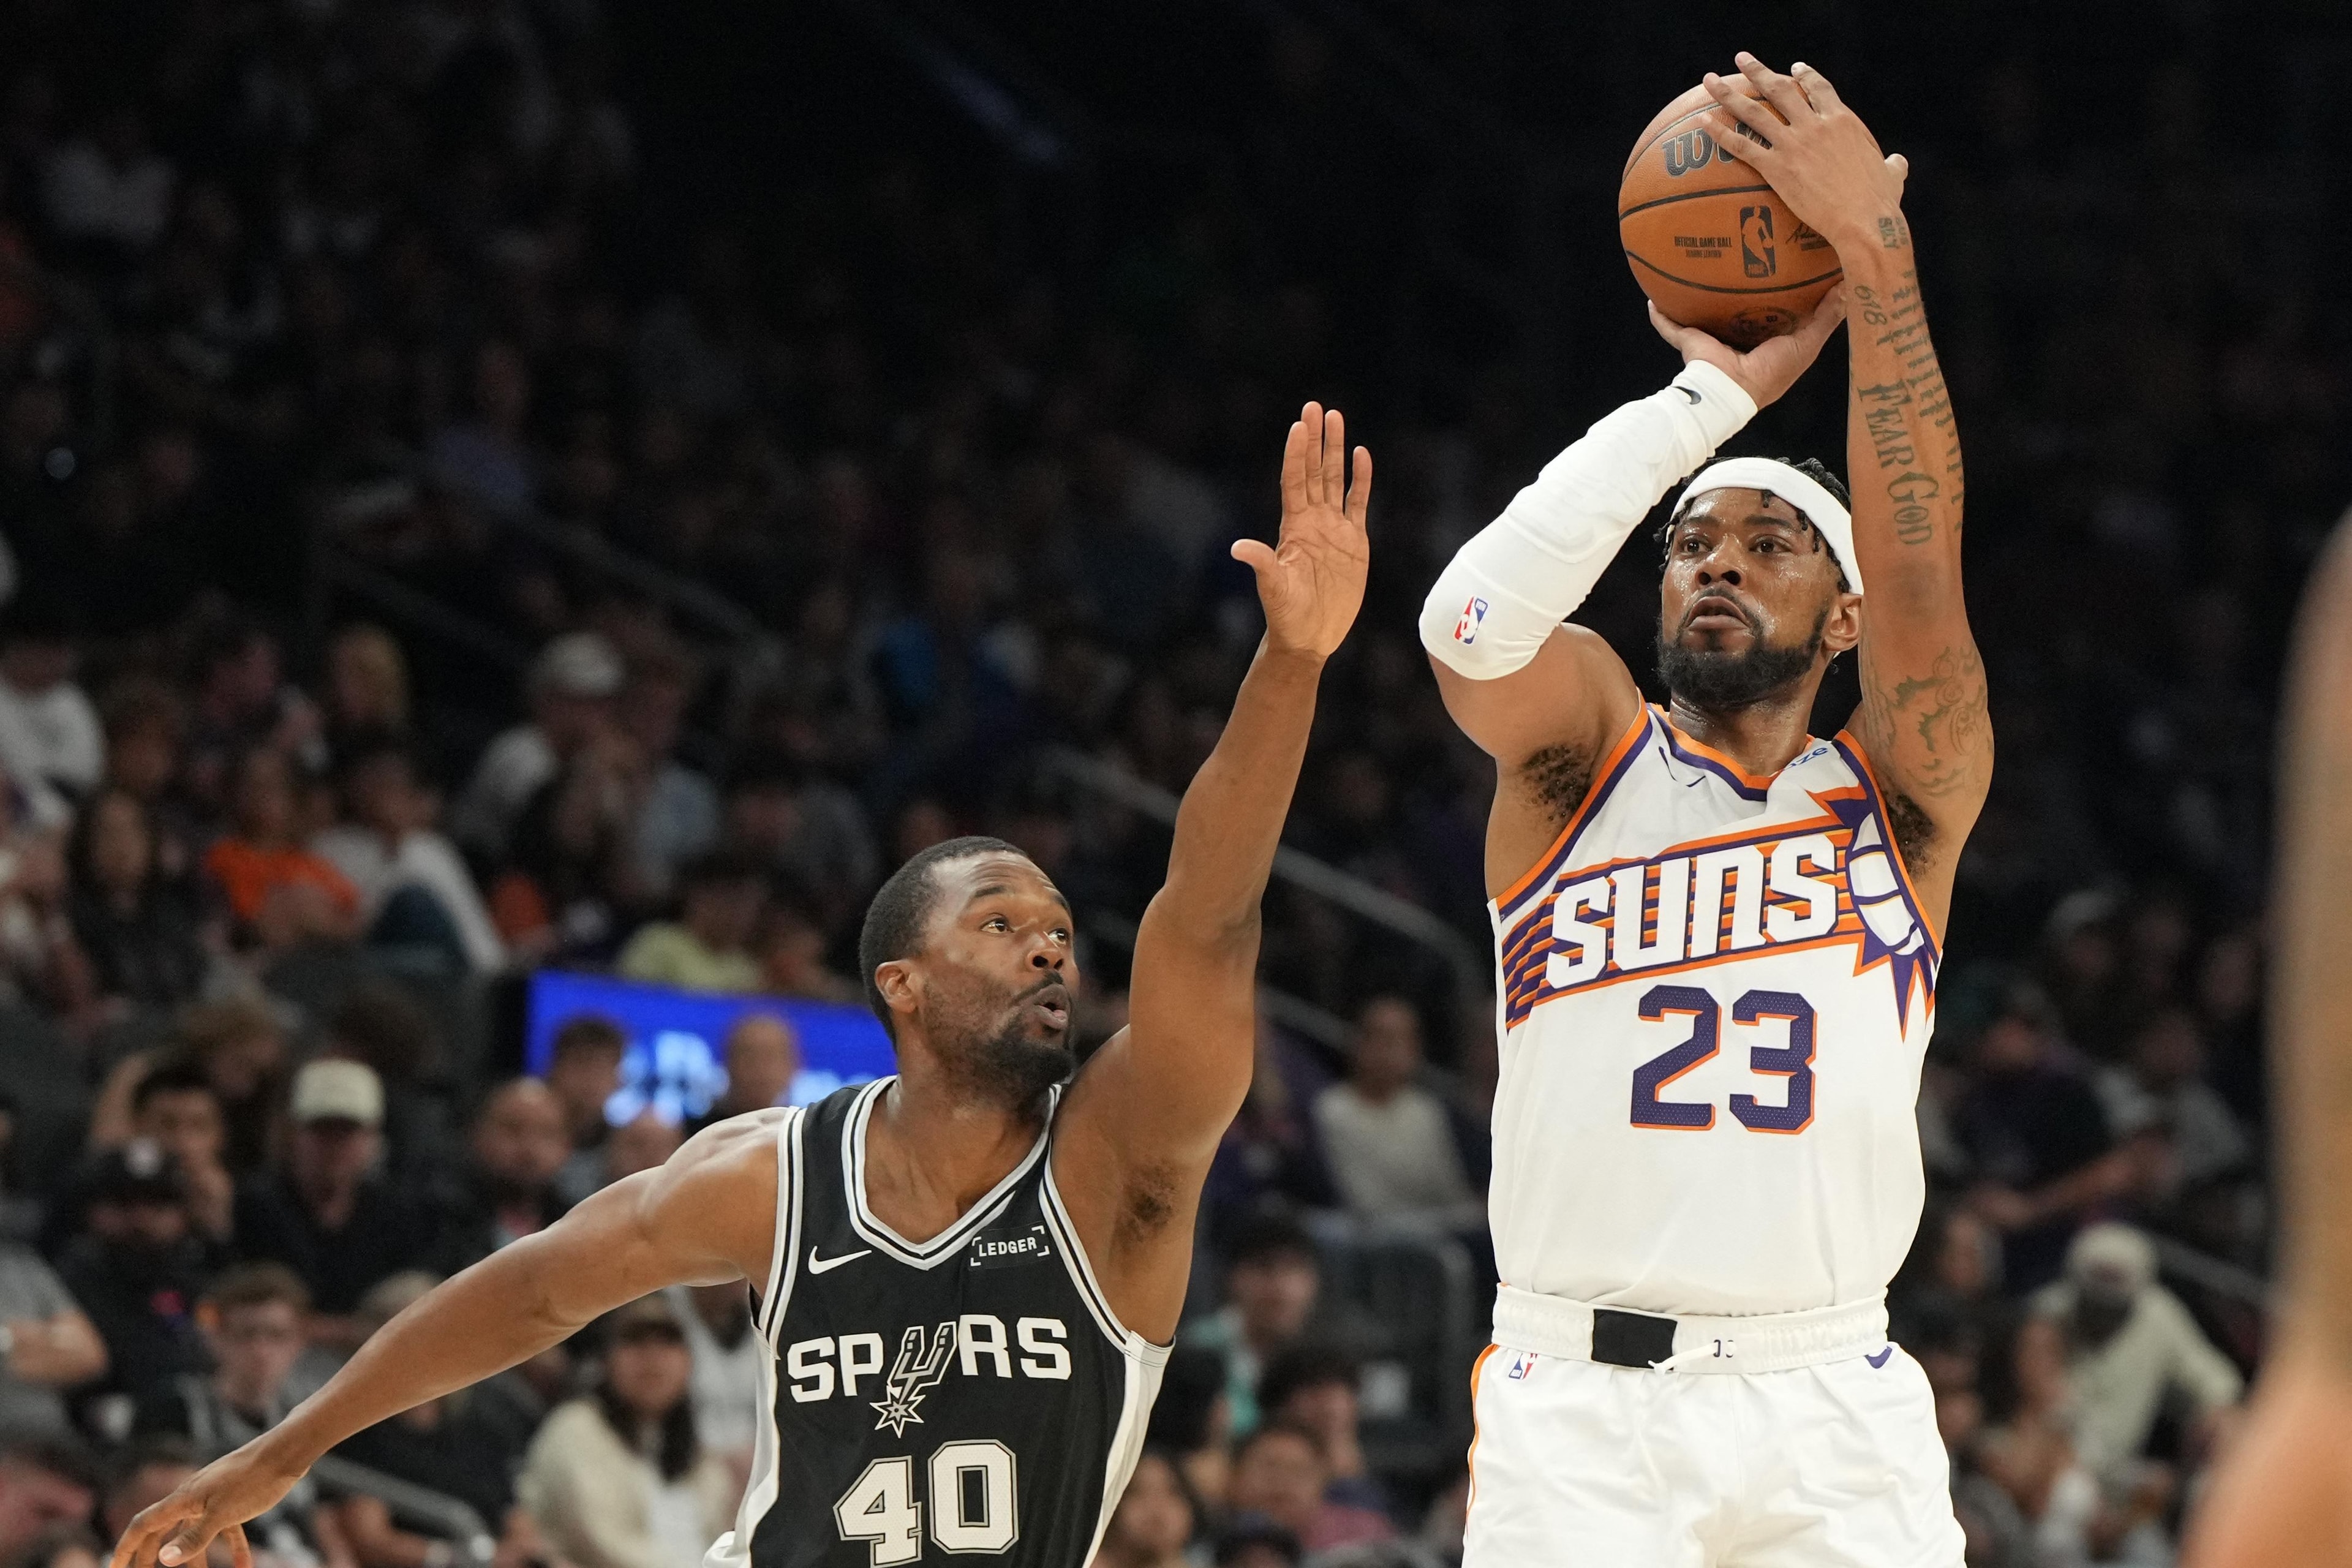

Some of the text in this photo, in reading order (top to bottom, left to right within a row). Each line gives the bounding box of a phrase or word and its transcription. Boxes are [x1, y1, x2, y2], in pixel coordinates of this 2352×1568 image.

[1854, 285, 1887, 326] 618
[1630, 984, 1819, 1135] 23
[979, 1237, 1037, 1257] LEDGER
[787, 1314, 1072, 1438] SPURS
[833, 1439, 1019, 1568] 40
